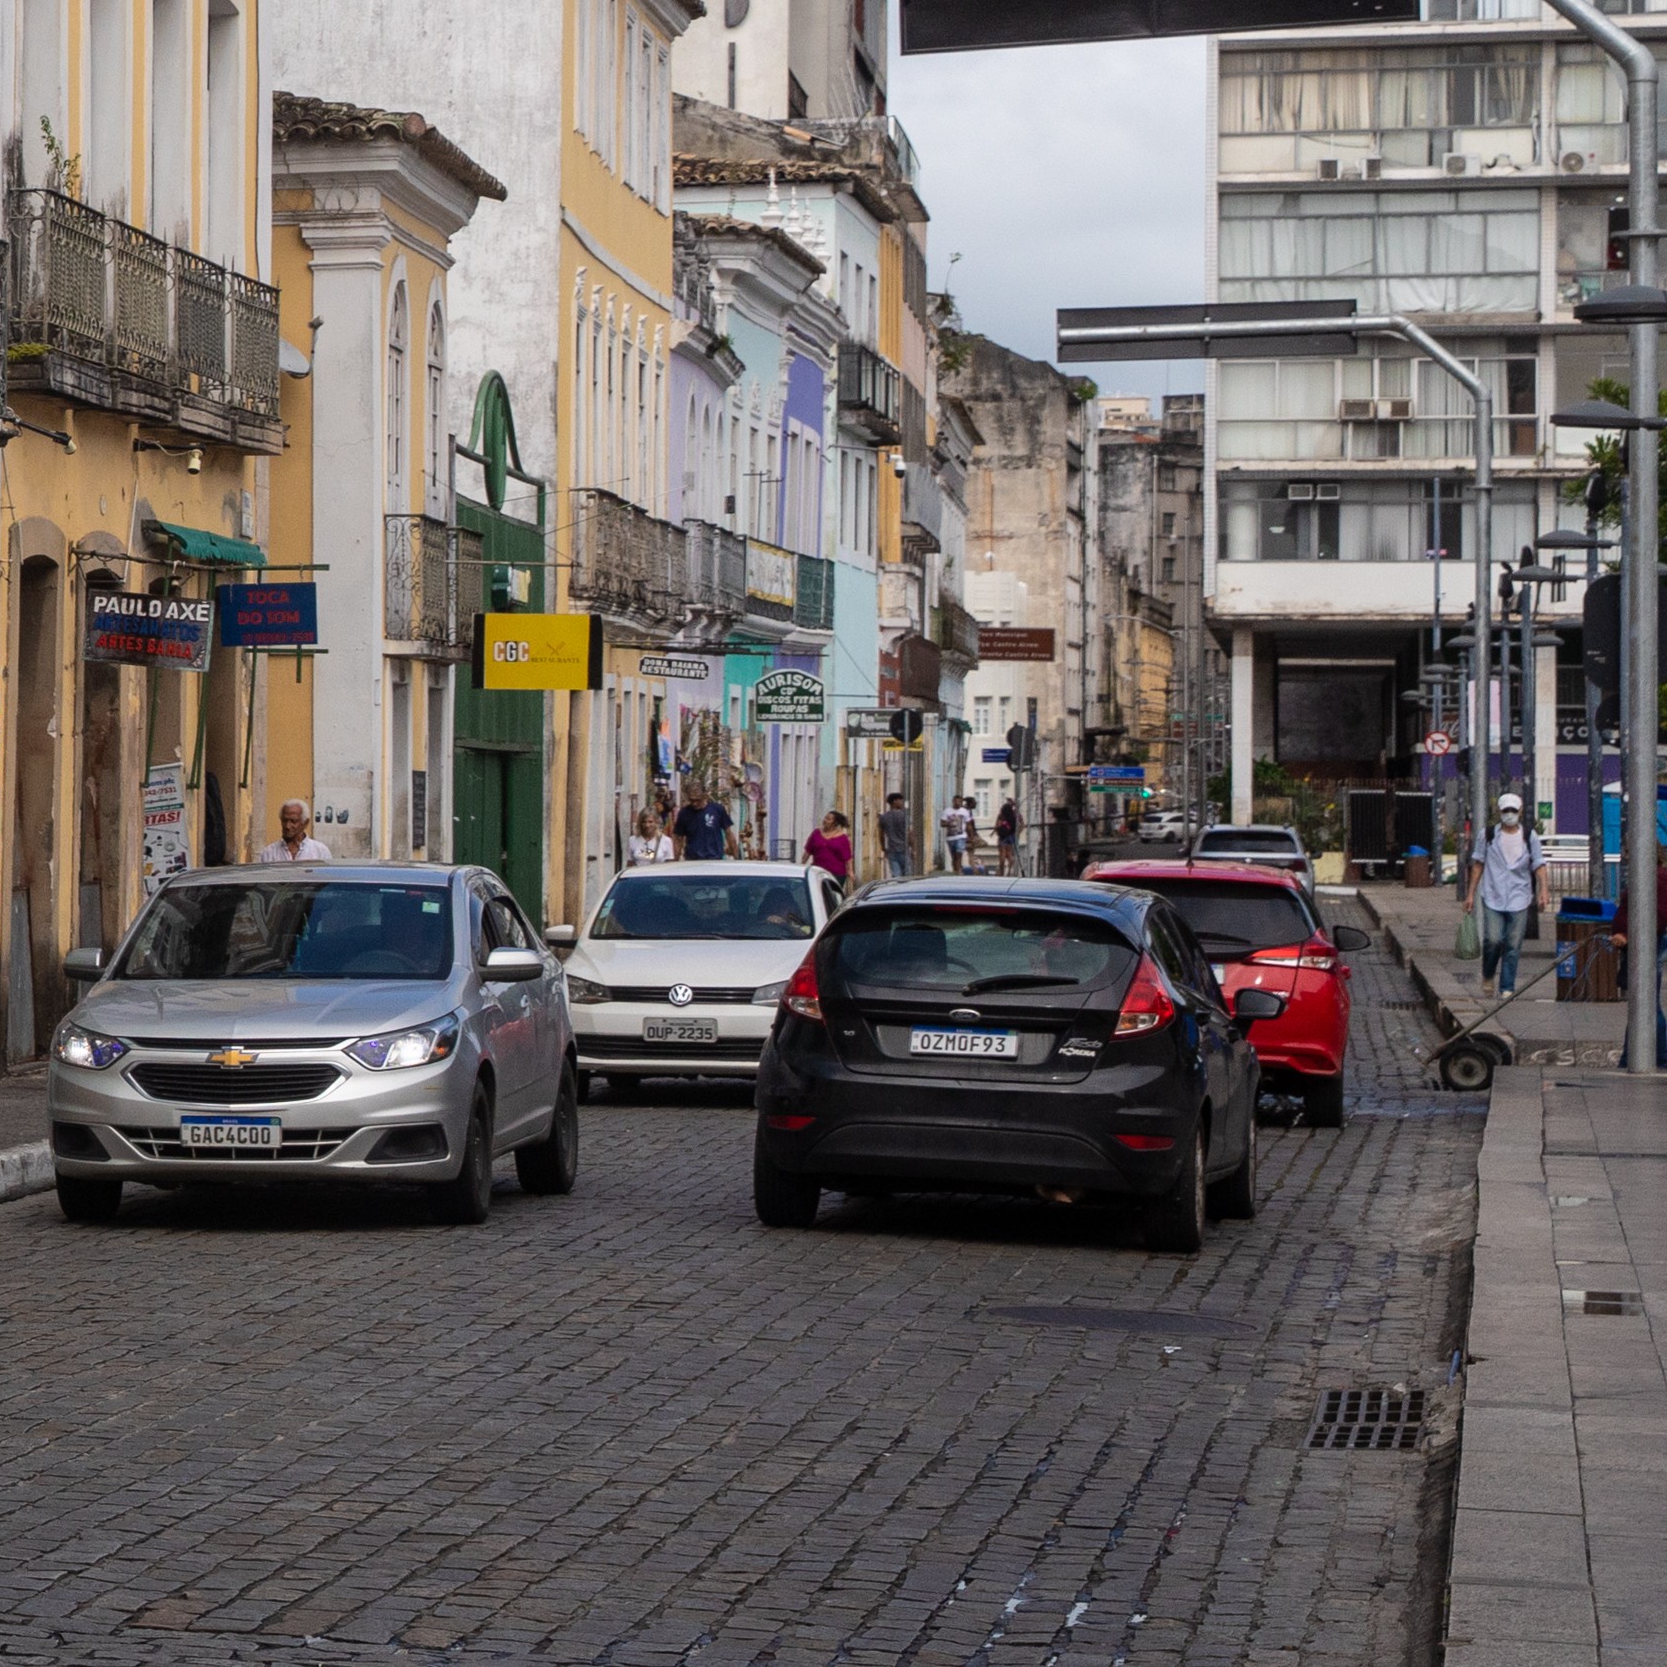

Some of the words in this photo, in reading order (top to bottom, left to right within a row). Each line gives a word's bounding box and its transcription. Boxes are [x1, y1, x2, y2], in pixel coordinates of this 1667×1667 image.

[93, 595, 162, 618] PAULO
[246, 590, 290, 605] TOCA
[237, 611, 263, 625] DO
[96, 634, 143, 652] ARTES
[493, 640, 530, 663] CGC
[758, 673, 822, 696] AURISOM
[647, 1026, 713, 1040] OUP-2235
